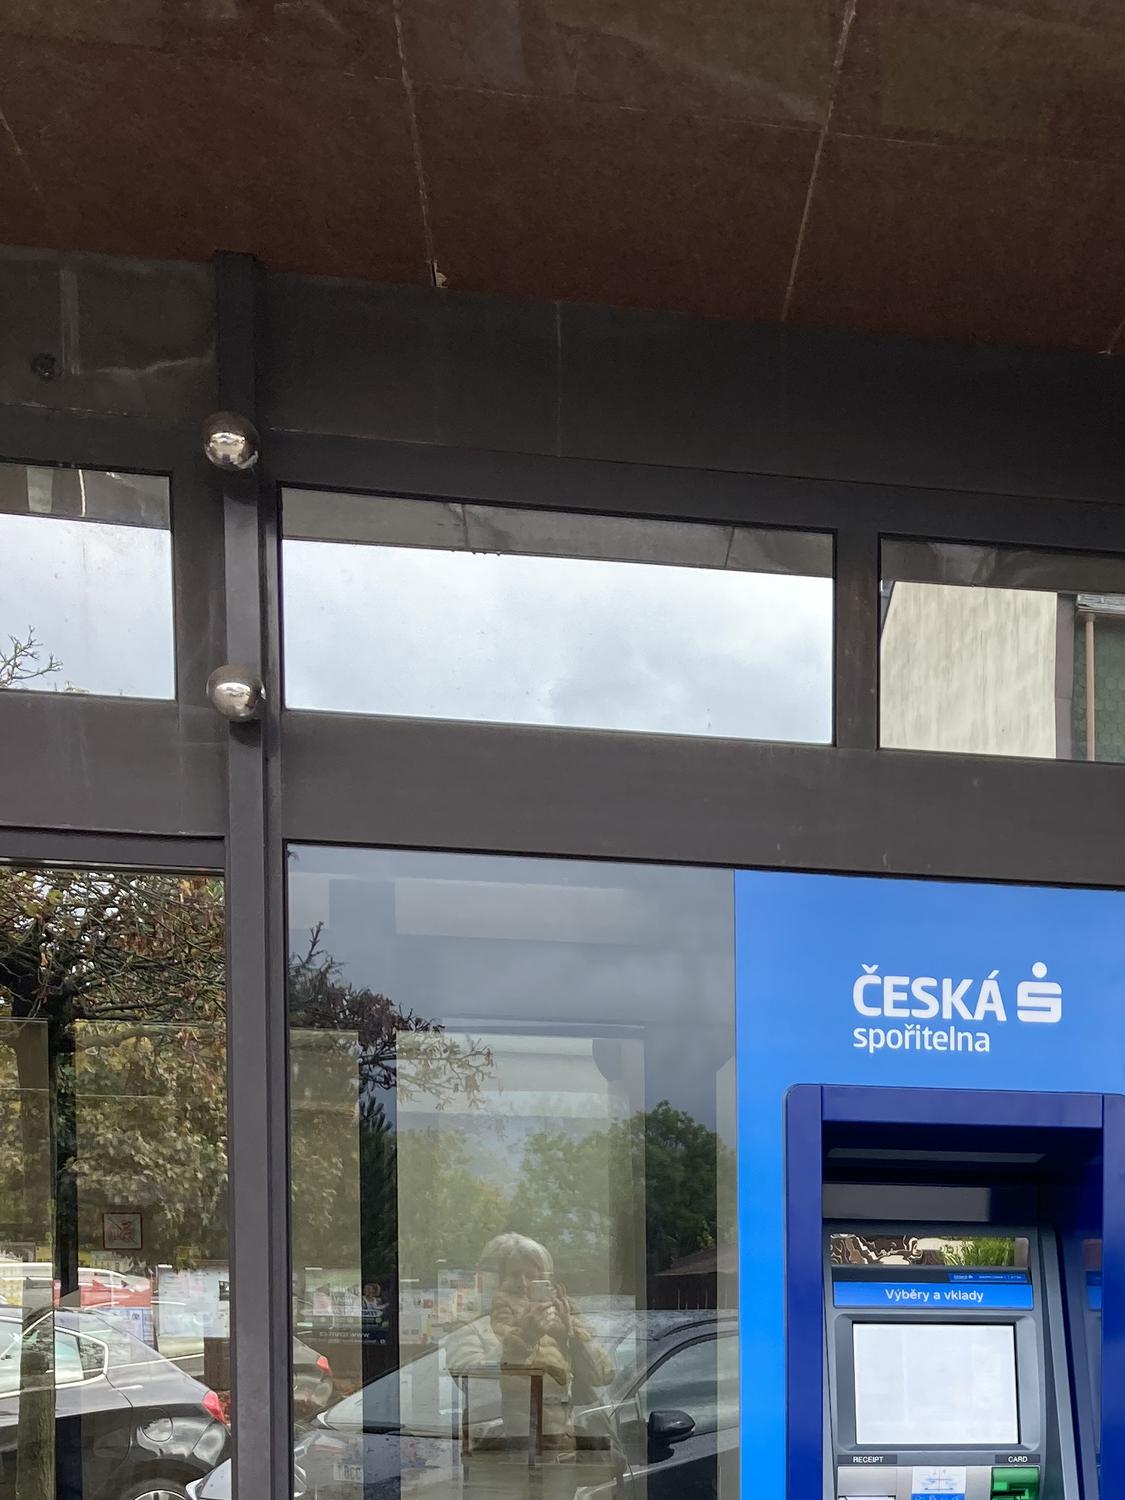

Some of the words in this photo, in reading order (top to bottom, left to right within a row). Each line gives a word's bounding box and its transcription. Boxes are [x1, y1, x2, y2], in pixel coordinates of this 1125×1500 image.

[852, 963, 1007, 1022] ČESKÁ
[853, 1023, 991, 1054] spořitelna
[885, 1288, 929, 1302] Výběry
[933, 1291, 941, 1300] a
[944, 1290, 984, 1303] vklady
[852, 1456, 884, 1464] RECEIPT
[1007, 1456, 1028, 1464] CARD
